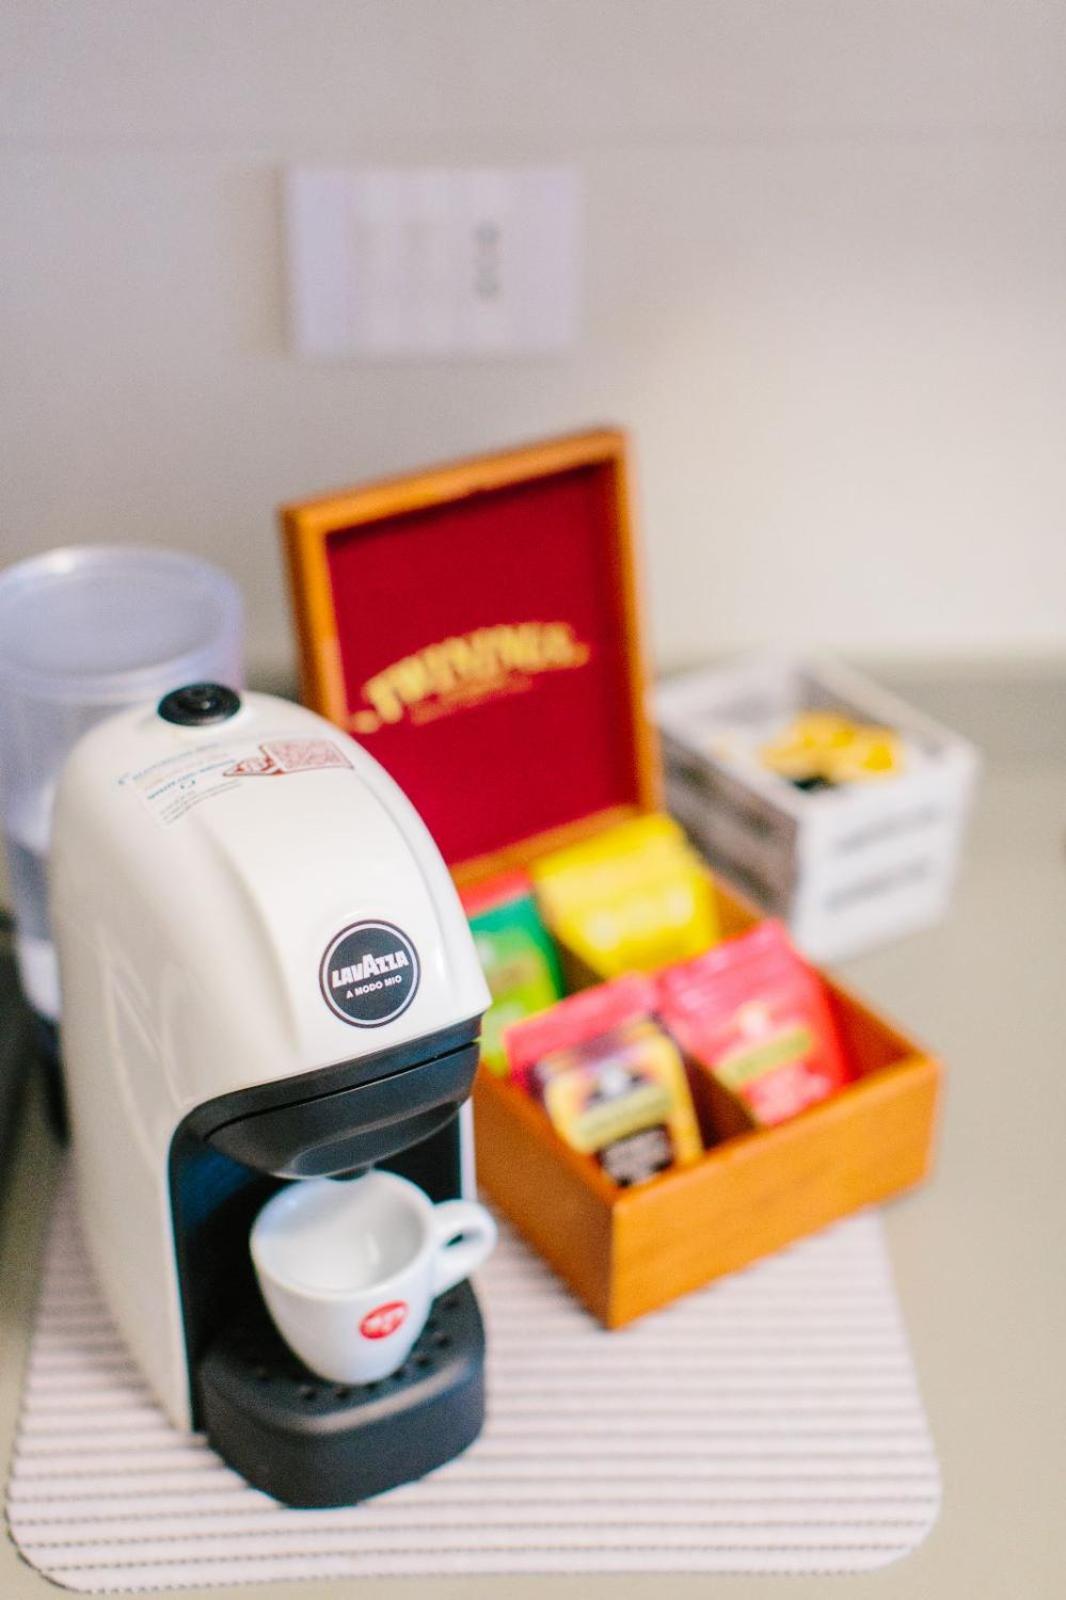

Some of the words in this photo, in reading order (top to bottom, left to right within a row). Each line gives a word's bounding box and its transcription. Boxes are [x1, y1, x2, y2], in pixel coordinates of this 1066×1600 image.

[331, 950, 410, 989] LAVAZZA
[346, 990, 354, 999] A
[354, 981, 383, 997] MODO
[384, 975, 402, 987] MIO
